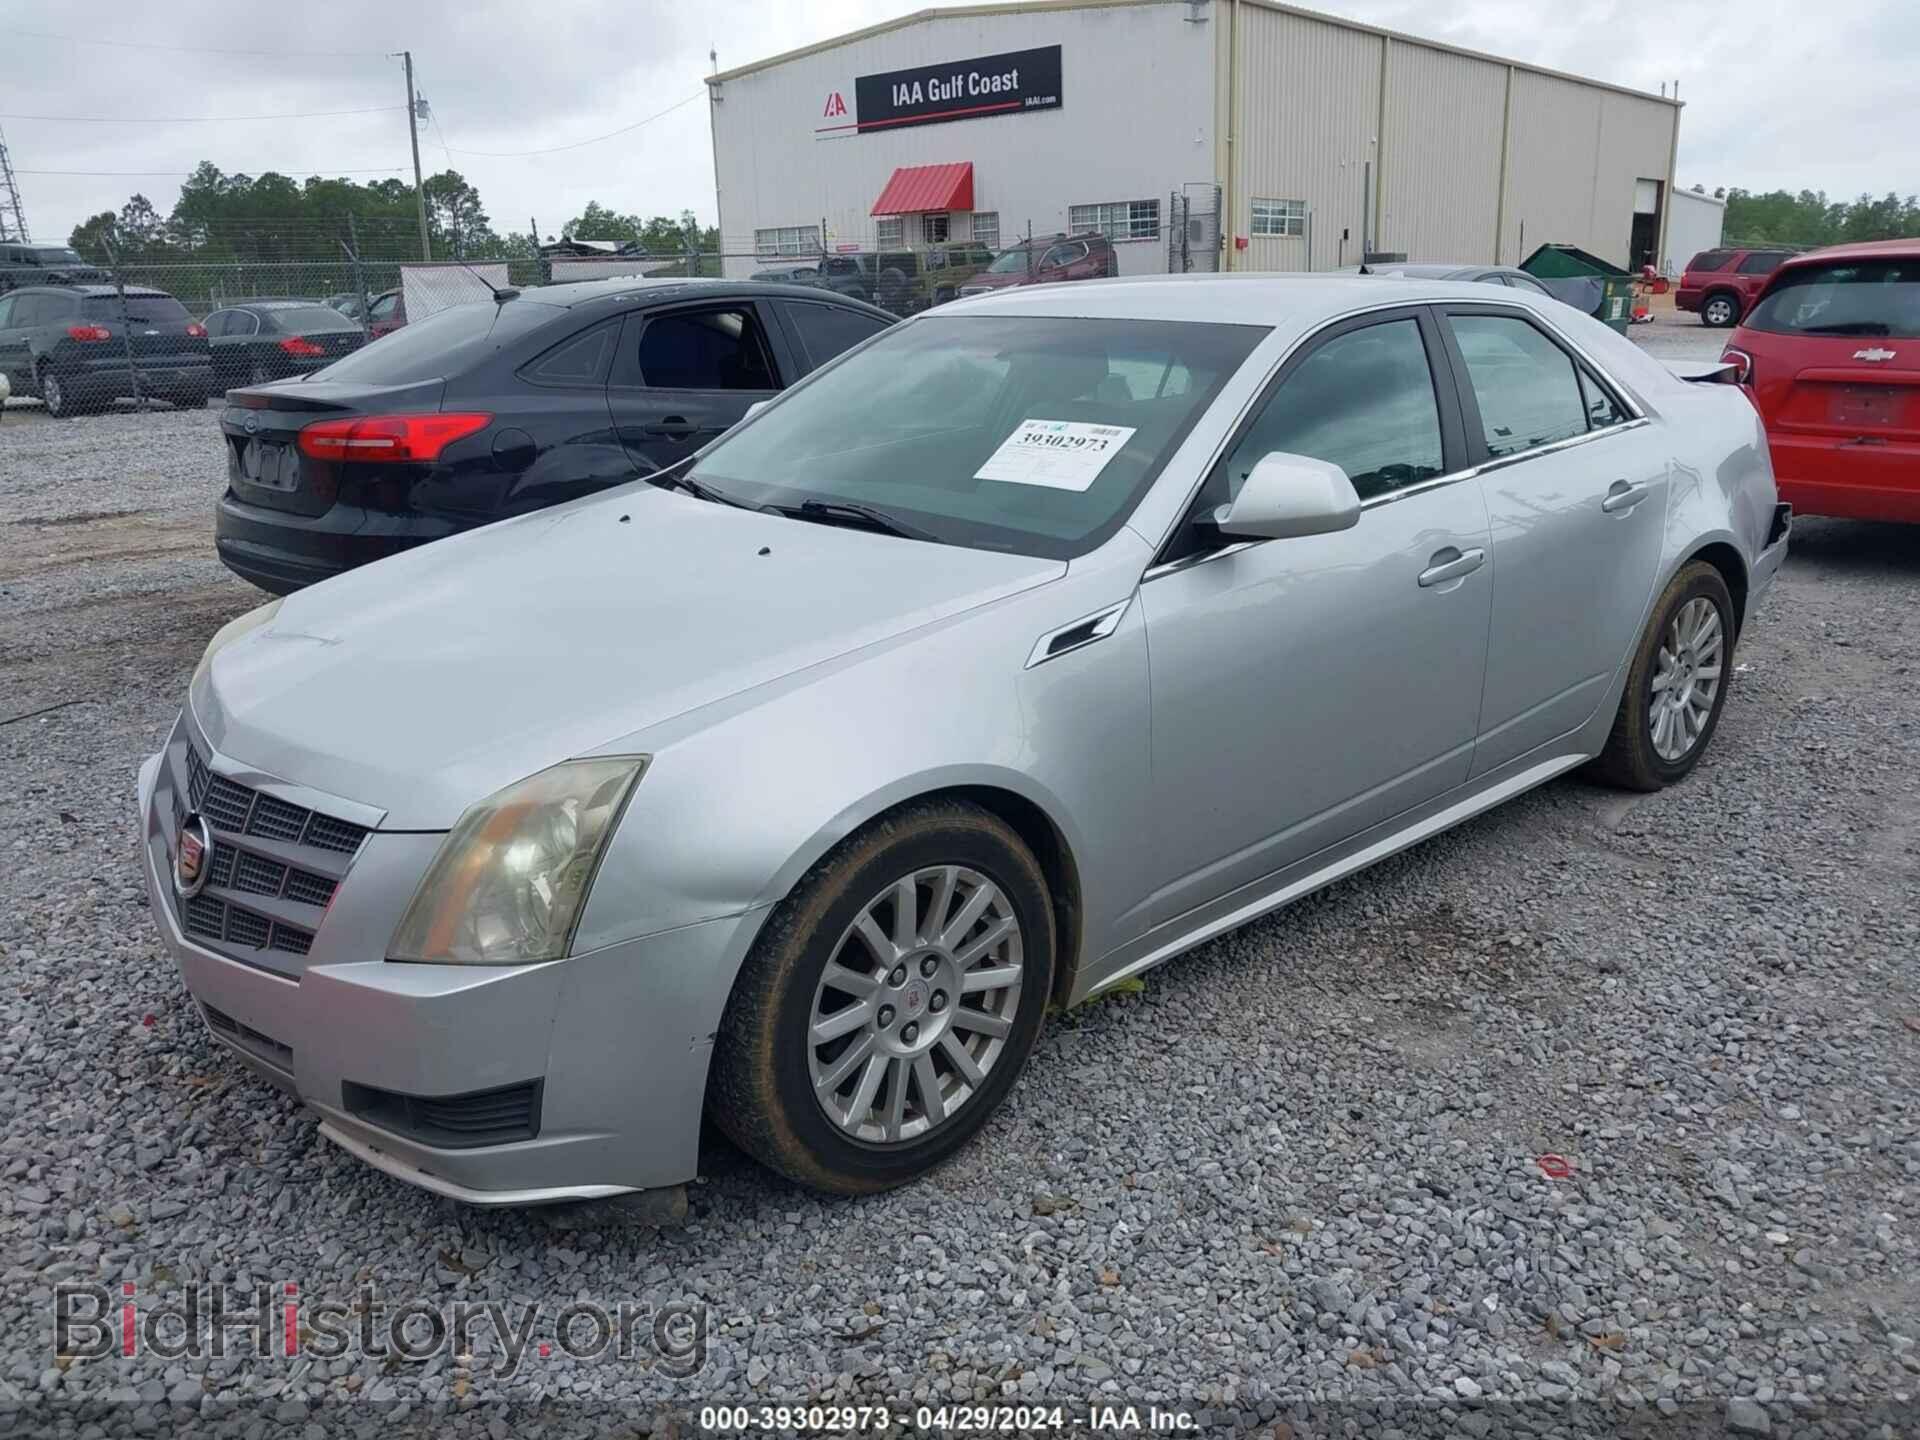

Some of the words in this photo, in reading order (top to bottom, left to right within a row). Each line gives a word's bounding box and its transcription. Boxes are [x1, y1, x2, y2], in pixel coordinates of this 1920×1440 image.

[892, 81, 924, 107] IAA
[928, 77, 964, 102] Gulf
[968, 69, 1019, 96] Coast
[1016, 432, 1109, 452] 39302973
